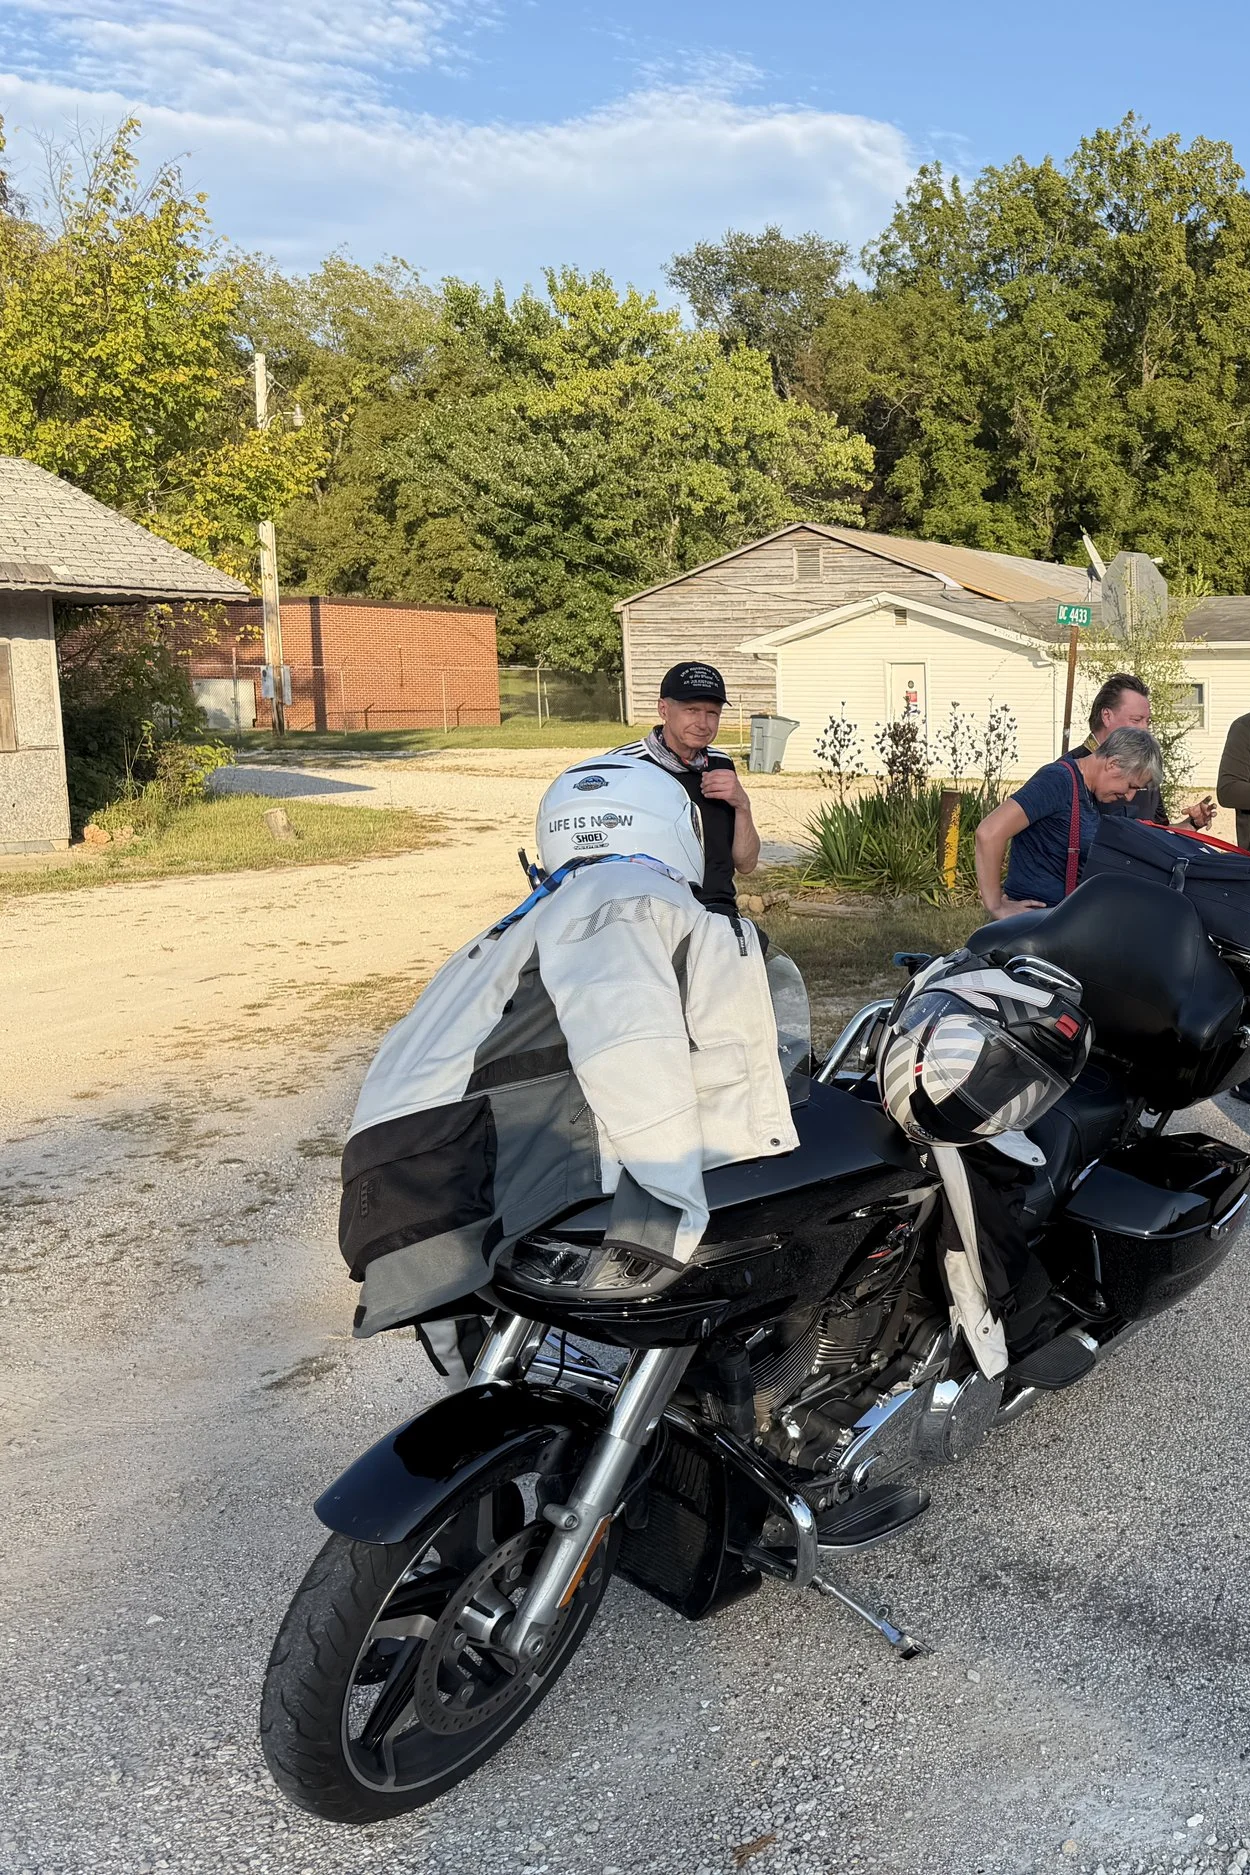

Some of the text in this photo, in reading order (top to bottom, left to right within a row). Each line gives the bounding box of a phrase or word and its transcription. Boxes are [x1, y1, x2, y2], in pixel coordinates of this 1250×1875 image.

[1059, 606, 1087, 623] DC 4433
[549, 813, 633, 833] LIFE IS NOW
[576, 833, 603, 843] SHOEI
